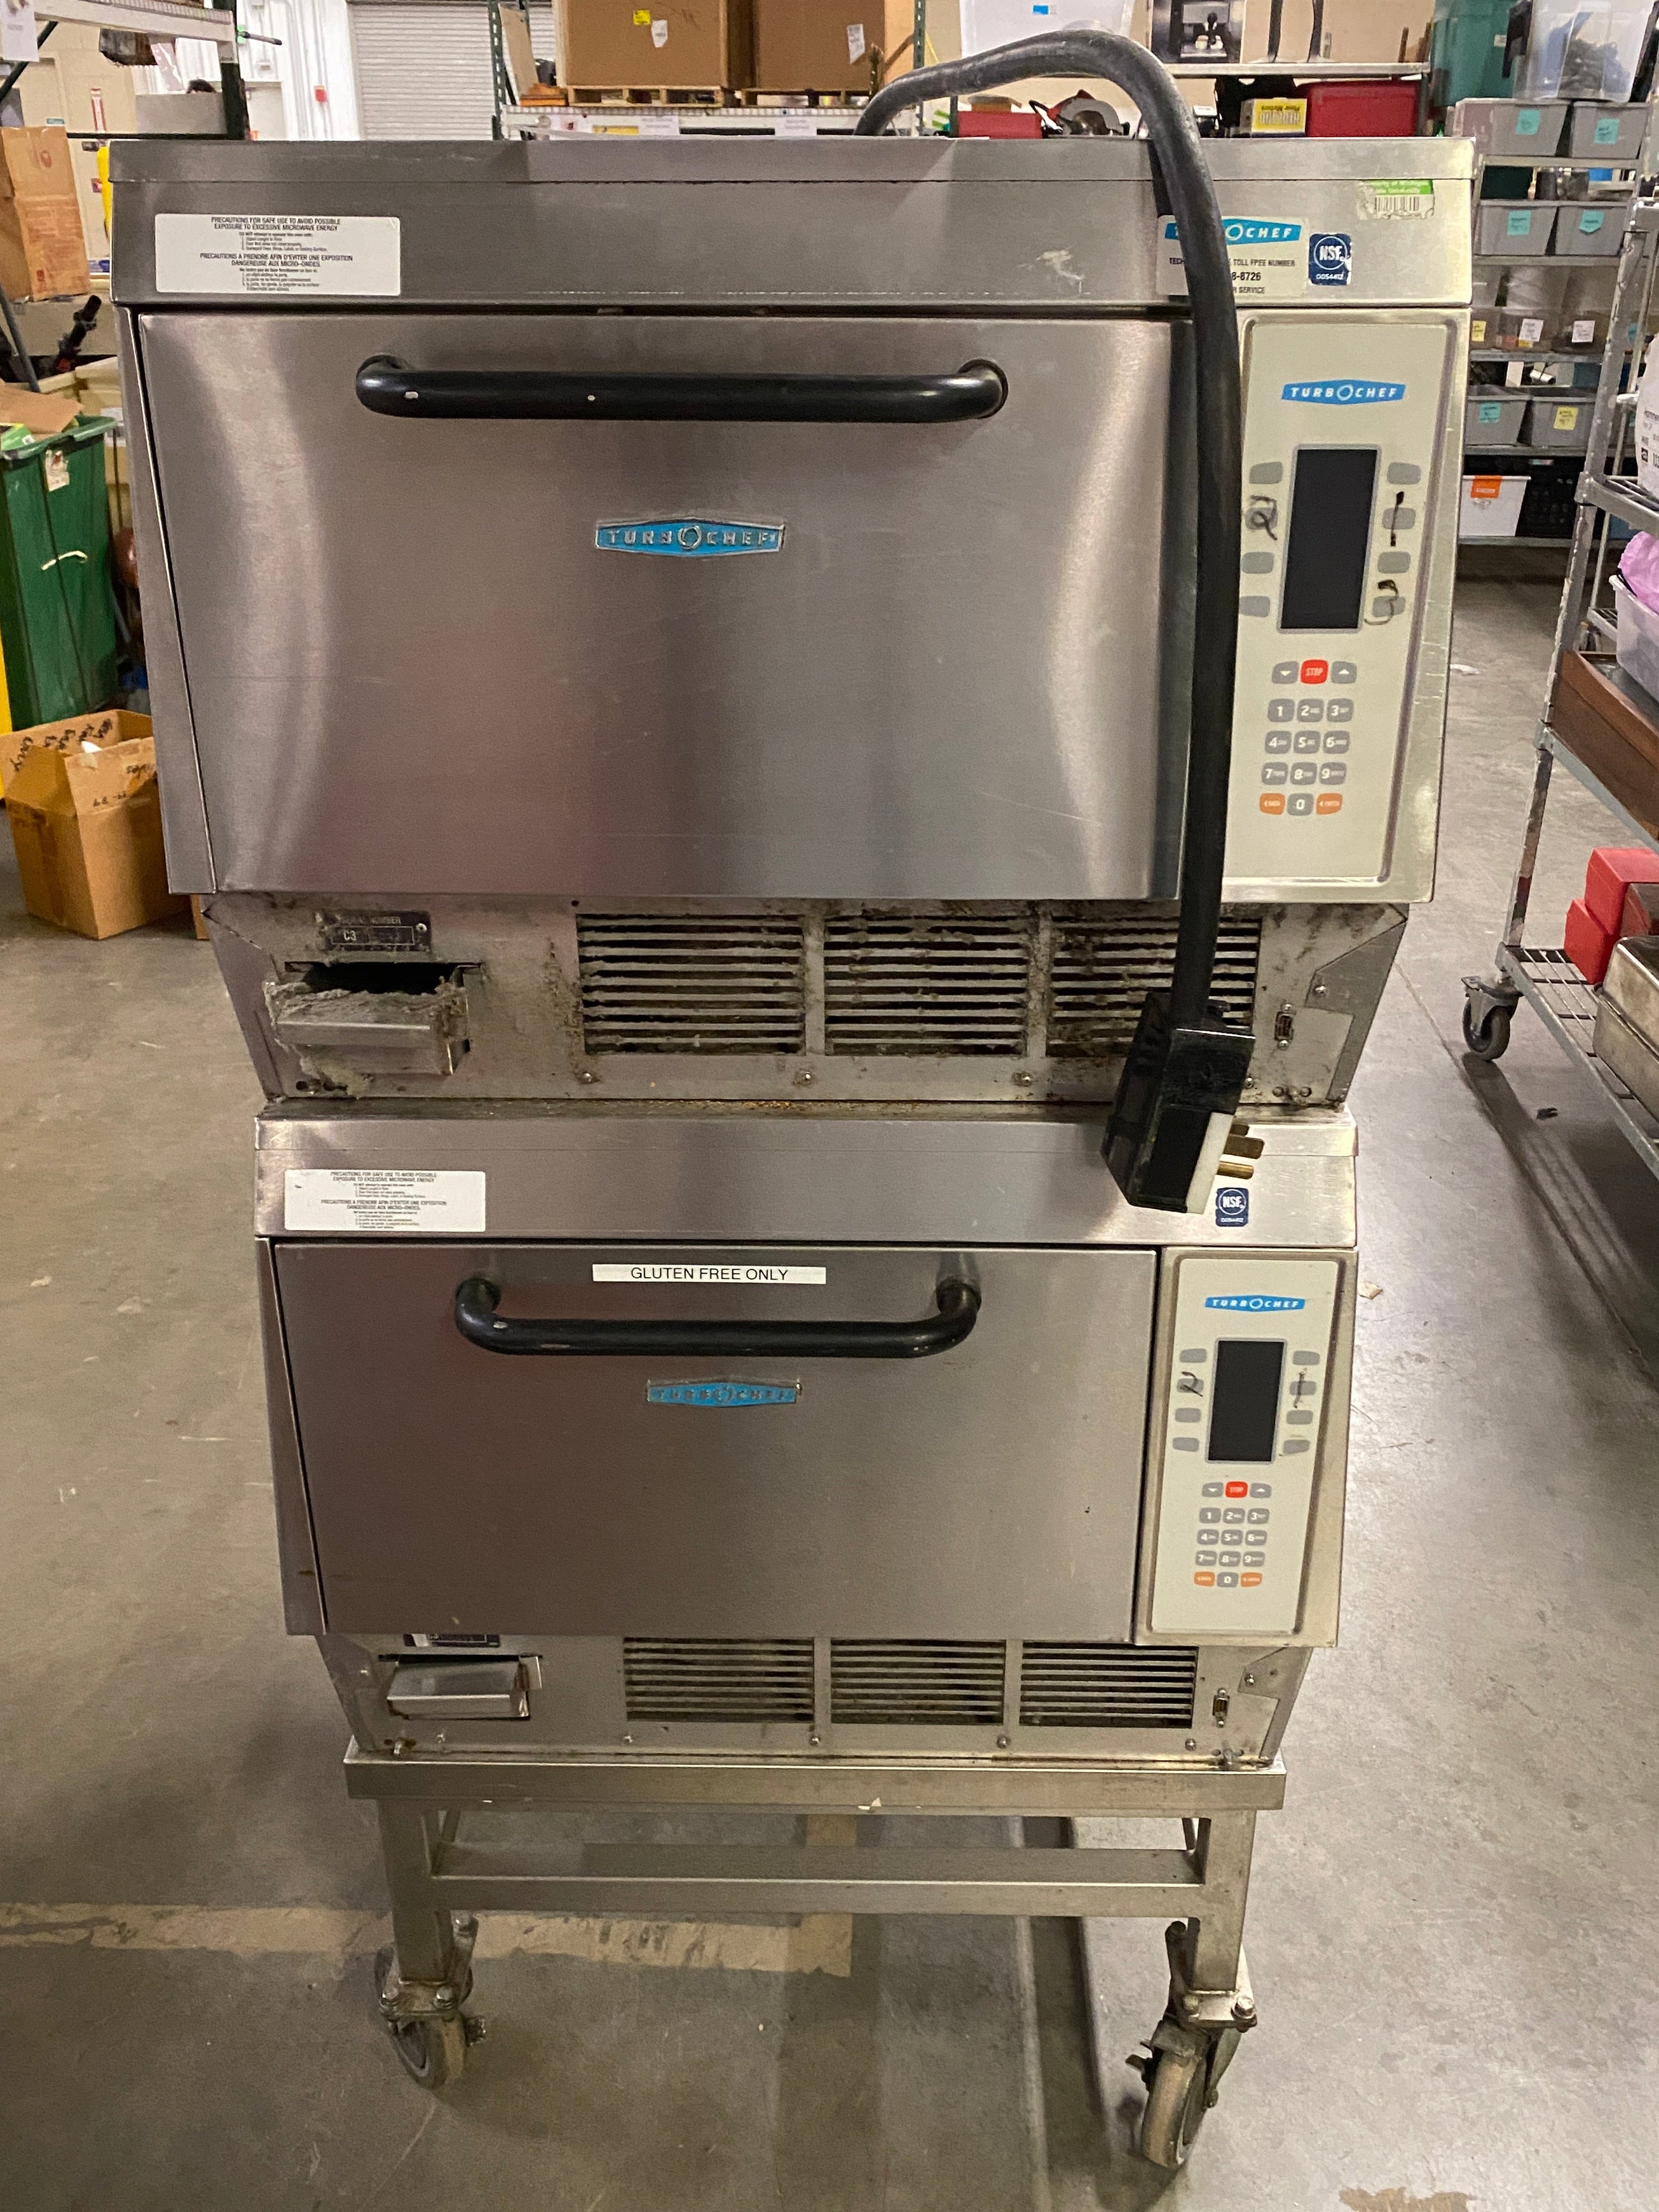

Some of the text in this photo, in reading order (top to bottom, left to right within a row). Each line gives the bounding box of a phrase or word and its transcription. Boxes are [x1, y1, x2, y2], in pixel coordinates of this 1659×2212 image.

[1320, 245, 1342, 261] NSF
[1231, 271, 1262, 281] 8-8726
[1291, 384, 1397, 400] TURBOCHEF
[608, 525, 768, 550] TURBOCHEF
[1306, 667, 1323, 676] STOP
[1277, 706, 1283, 716] 1
[1301, 705, 1310, 716] 2
[1330, 705, 1339, 716] 3
[1268, 737, 1277, 748] 4
[1298, 737, 1306, 748] 5
[1326, 737, 1335, 748] 6
[1265, 768, 1273, 779] 7
[1294, 769, 1303, 780] 8
[1321, 768, 1330, 779] 9
[1295, 800, 1306, 810] 0
[1222, 1196, 1242, 1208] NSF
[631, 1267, 789, 1281] GLUTEN FREE ONLY
[1213, 1299, 1299, 1309] TURBOCHEF
[1222, 1555, 1229, 1563] 8
[1245, 1555, 1252, 1563] 9
